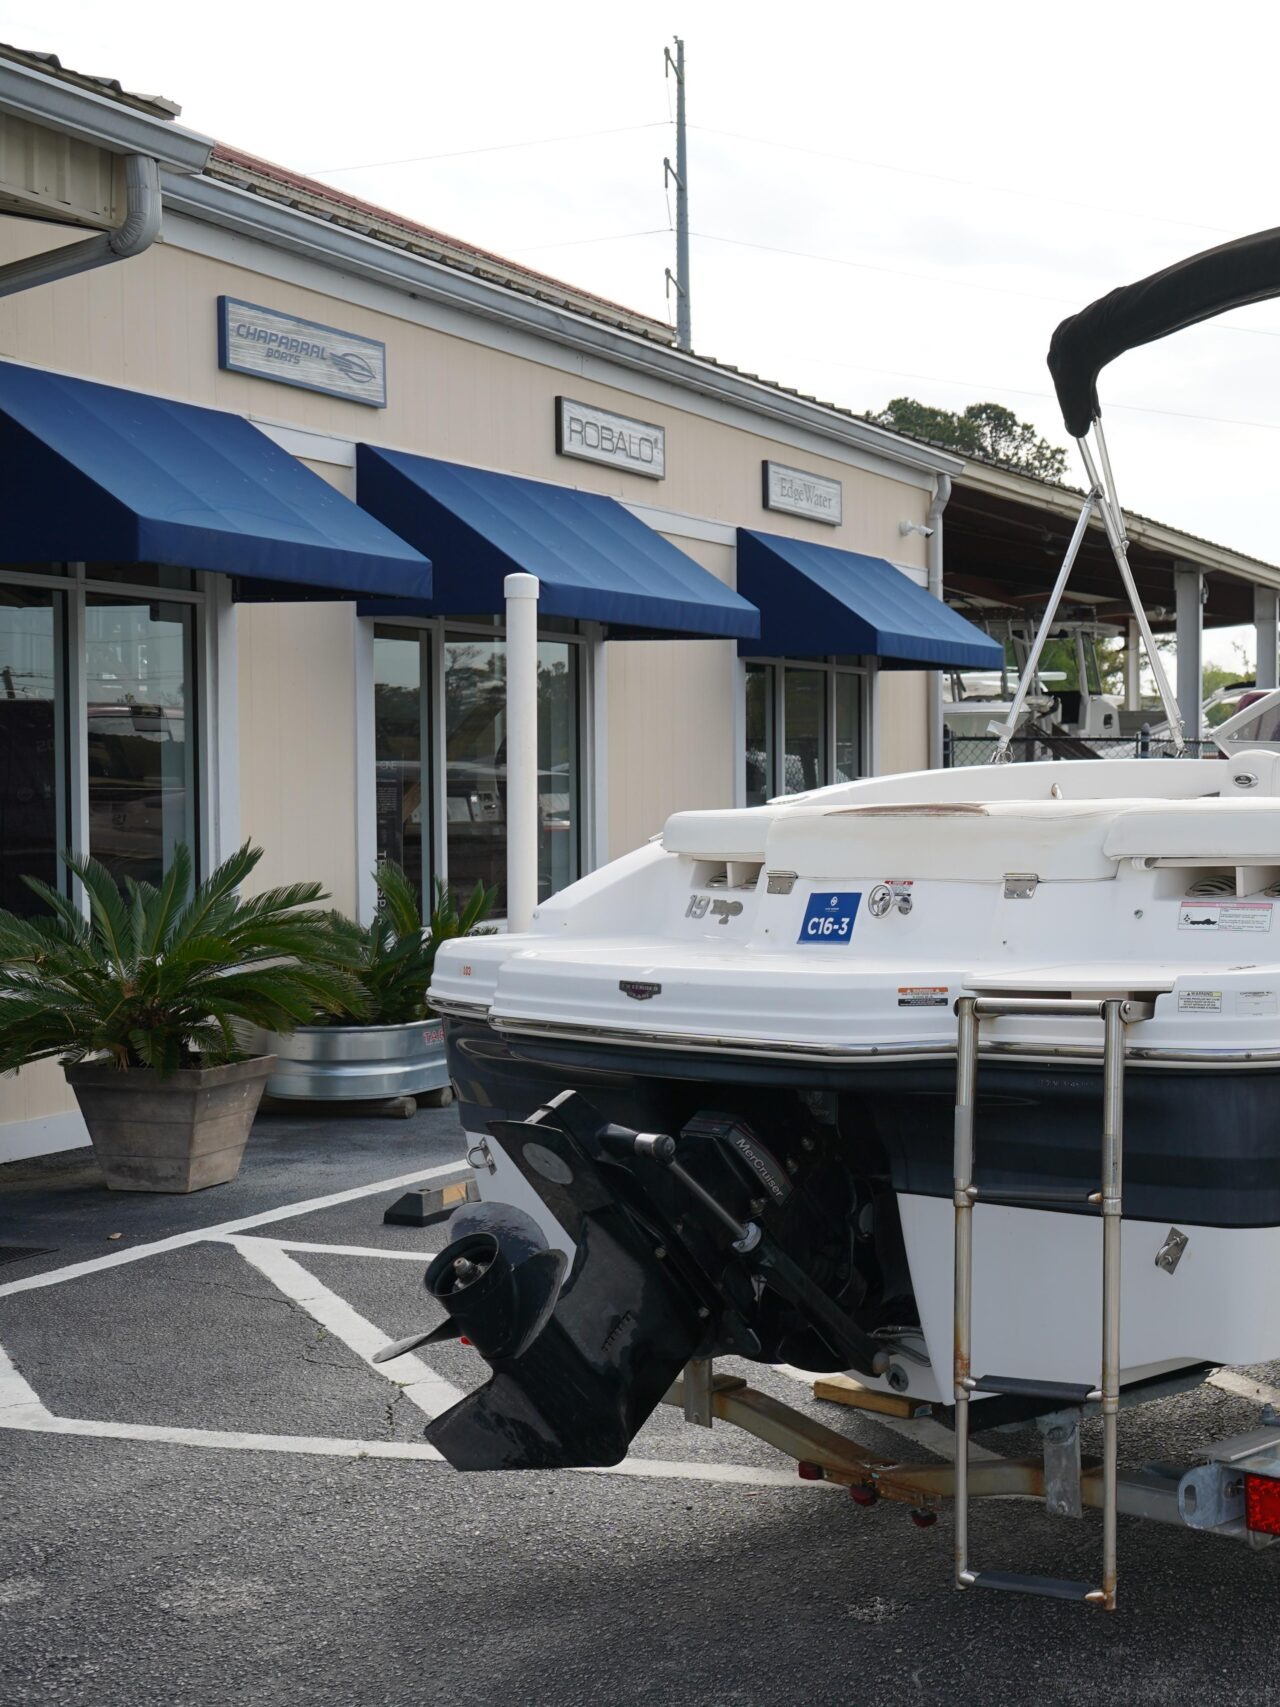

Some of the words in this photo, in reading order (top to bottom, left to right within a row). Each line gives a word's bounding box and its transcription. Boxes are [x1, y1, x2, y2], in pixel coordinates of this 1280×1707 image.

[236, 323, 327, 361] CHAPARRAL
[264, 347, 300, 365] BOATS
[569, 415, 654, 464] ROBALO
[780, 477, 832, 509] EdgeWater
[807, 917, 850, 935] C16-3
[735, 1138, 784, 1197] MerCruiser
